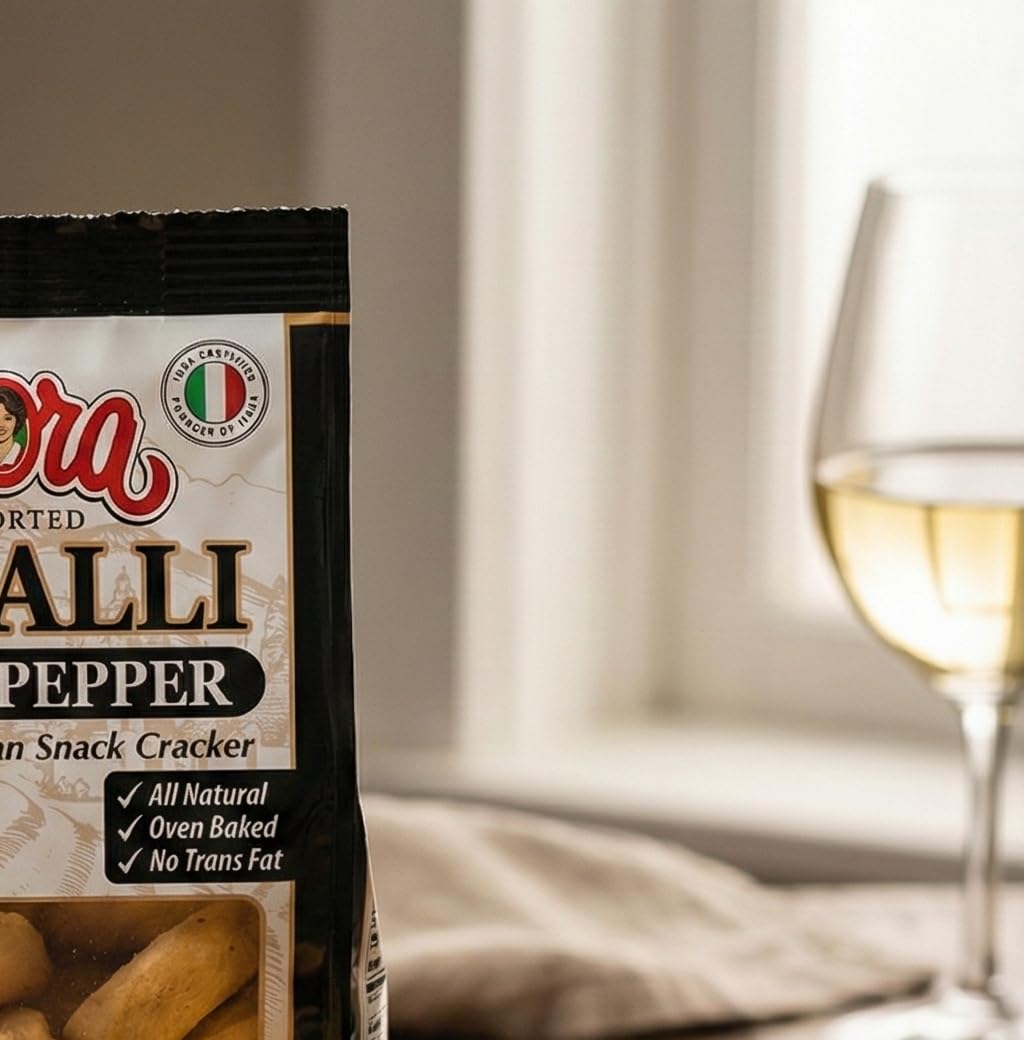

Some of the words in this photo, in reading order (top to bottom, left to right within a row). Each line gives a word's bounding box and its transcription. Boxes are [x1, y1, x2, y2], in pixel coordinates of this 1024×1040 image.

[35, 730, 125, 761] Snack
[136, 729, 256, 760] Cracker
[149, 782, 179, 807] All
[182, 781, 269, 806] Natural
[149, 815, 204, 840] Oven
[209, 814, 279, 839] Baked
[149, 848, 179, 872] No
[185, 848, 243, 872] Trans
[247, 848, 284, 871] Fat
